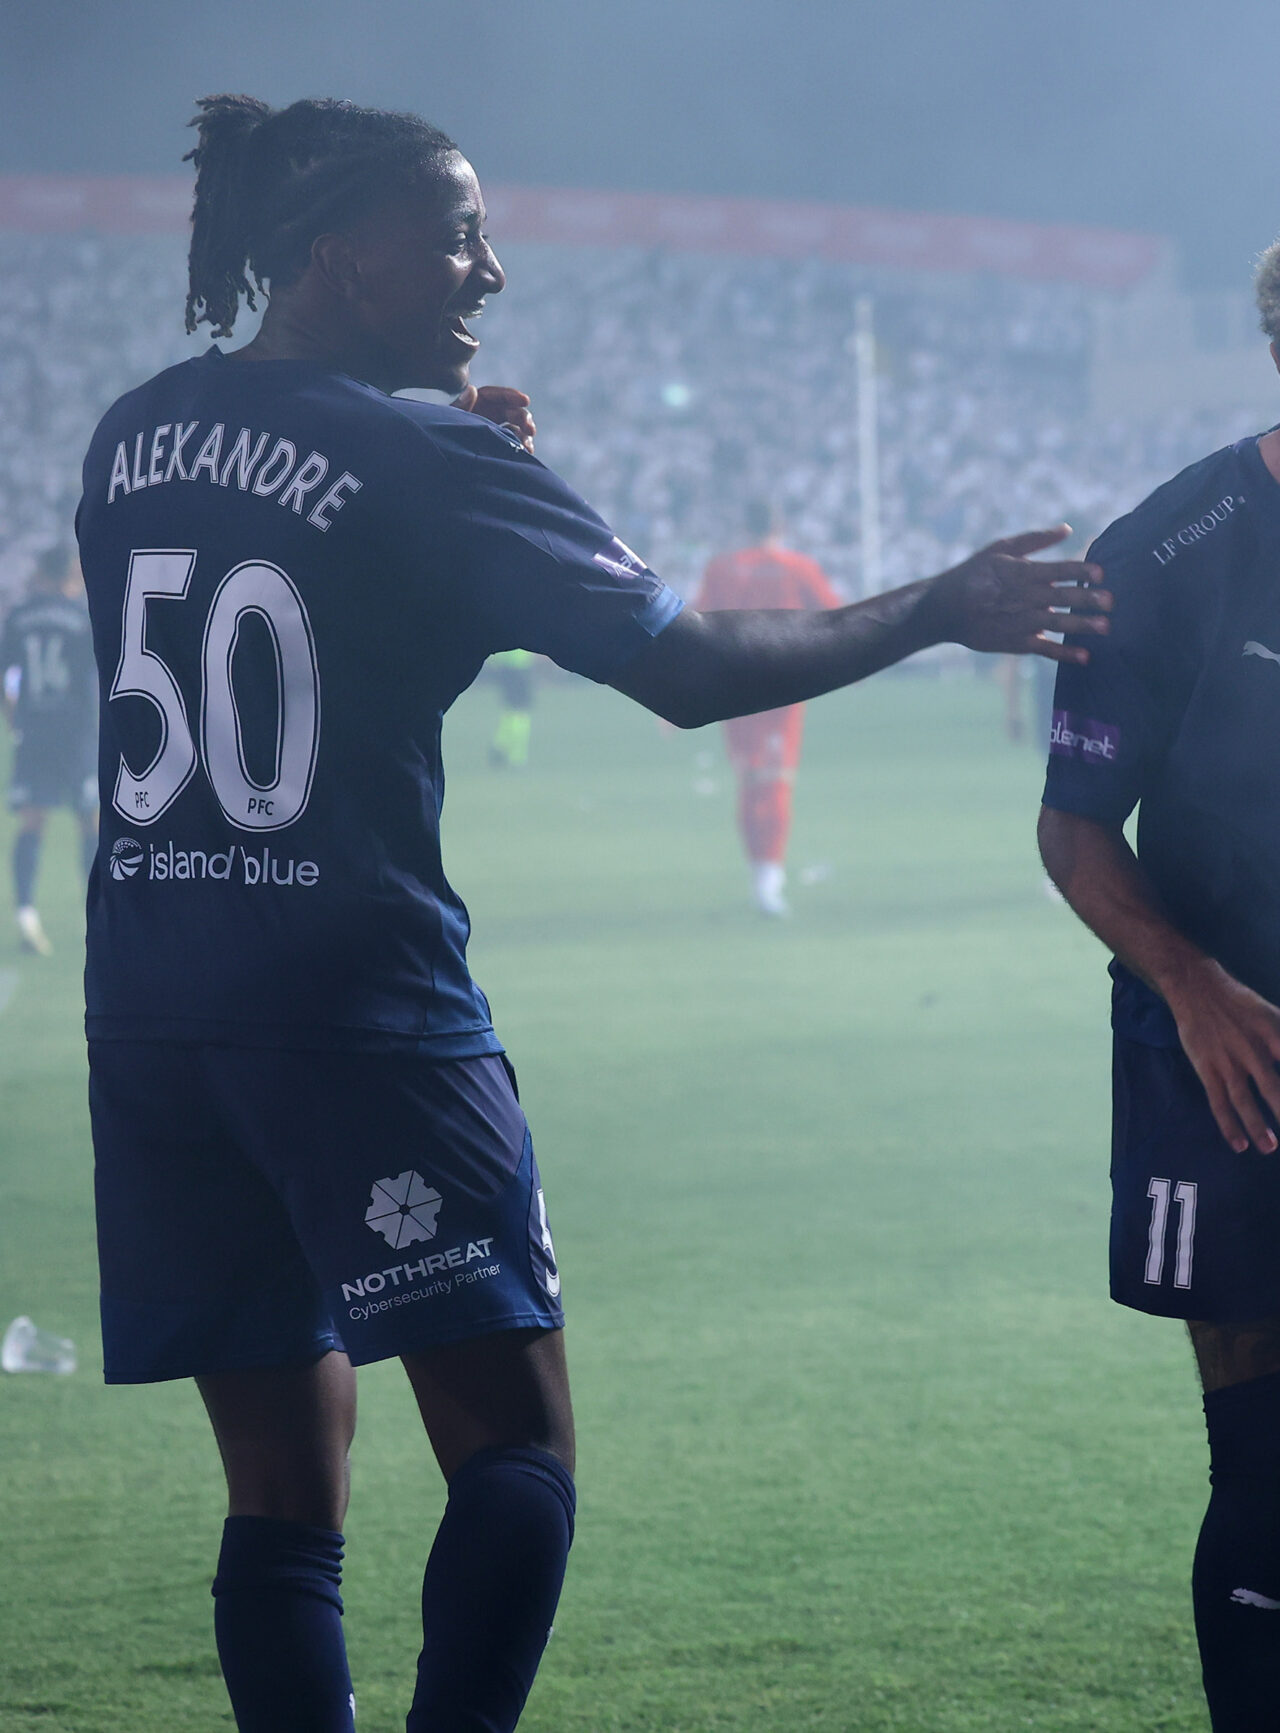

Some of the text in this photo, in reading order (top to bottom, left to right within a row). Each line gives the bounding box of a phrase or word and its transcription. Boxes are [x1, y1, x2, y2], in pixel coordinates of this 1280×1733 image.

[108, 421, 363, 532] ALEXANDRE
[108, 549, 320, 832] 50
[135, 791, 150, 808] PFC
[247, 798, 275, 816] PFC
[149, 841, 320, 886] island blue
[1143, 1177, 1198, 1289] 11
[341, 1237, 494, 1302] NOTHREAT
[349, 1263, 501, 1320] Cybersecurity Partner
